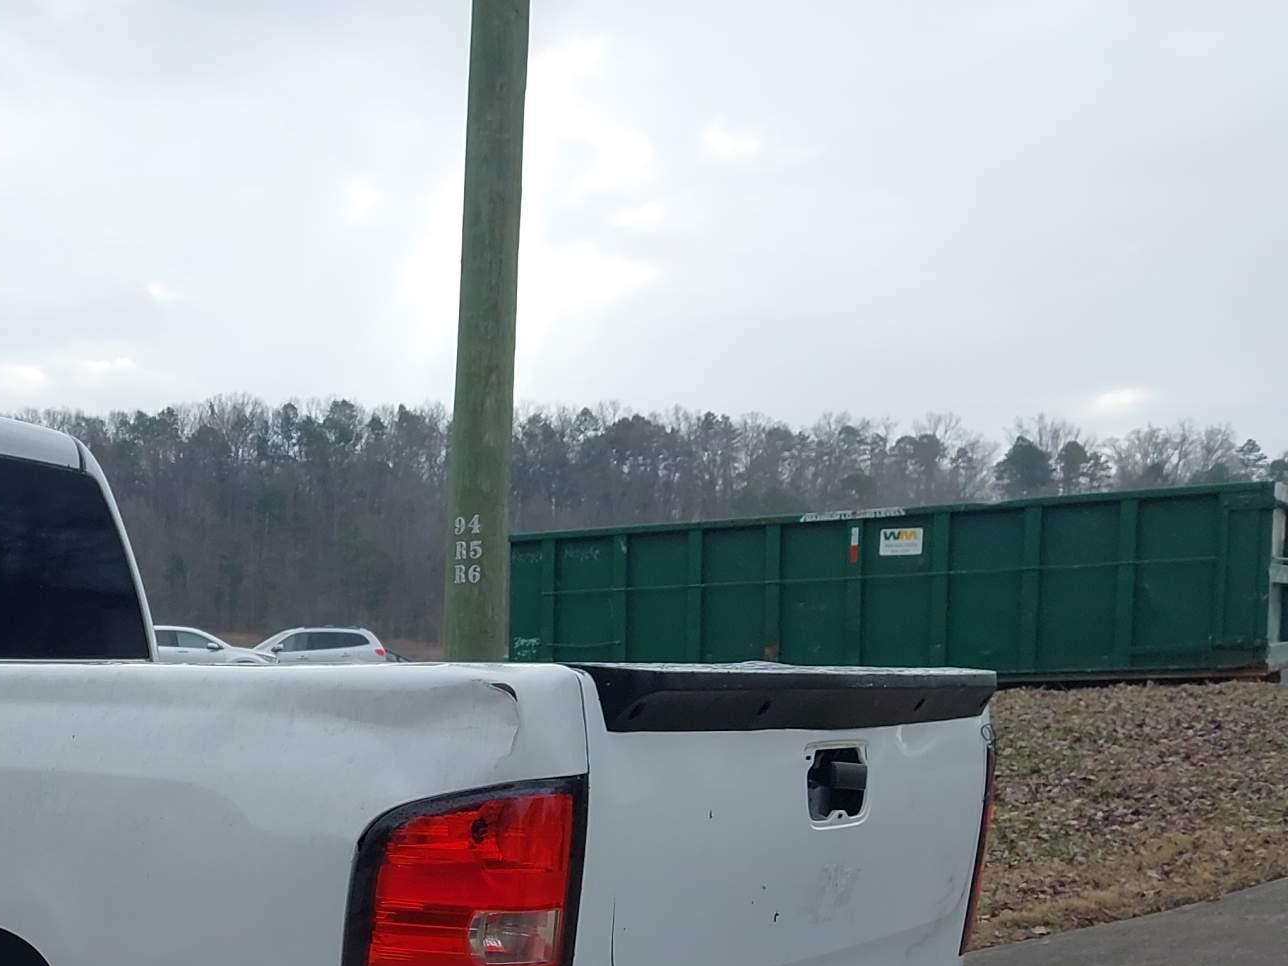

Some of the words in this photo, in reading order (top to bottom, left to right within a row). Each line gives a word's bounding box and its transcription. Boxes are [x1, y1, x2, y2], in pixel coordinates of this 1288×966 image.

[454, 513, 481, 535] 94
[883, 530, 918, 541] WM
[454, 564, 481, 584] R6
